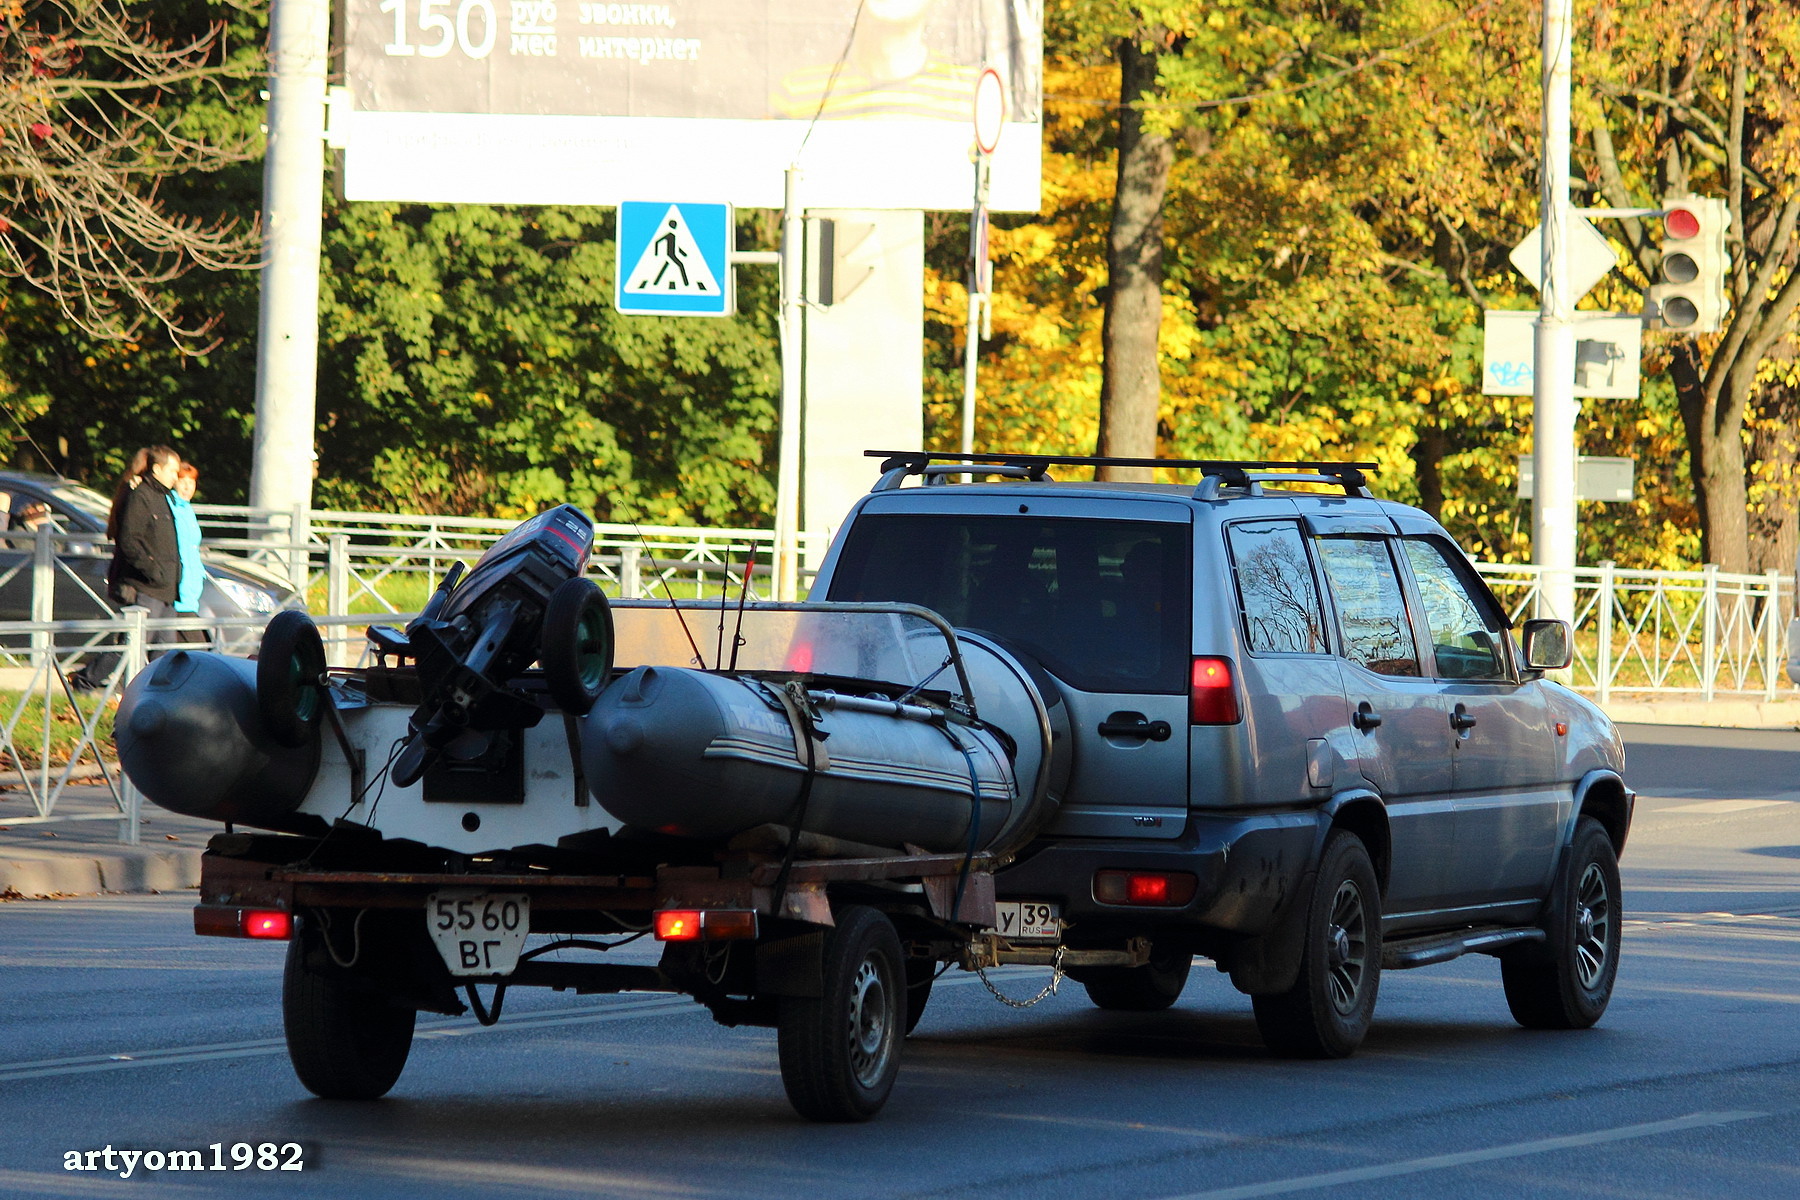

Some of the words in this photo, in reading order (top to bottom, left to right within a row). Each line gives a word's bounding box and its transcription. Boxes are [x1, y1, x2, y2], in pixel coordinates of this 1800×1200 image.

[511, 0, 558, 27] руб
[578, 3, 677, 29] звонки,
[380, 0, 497, 59] 150
[510, 34, 558, 57] мес
[578, 36, 701, 65] интернет
[1023, 904, 1051, 926] 39
[1022, 926, 1041, 935] RUS
[459, 940, 501, 969] ВГ
